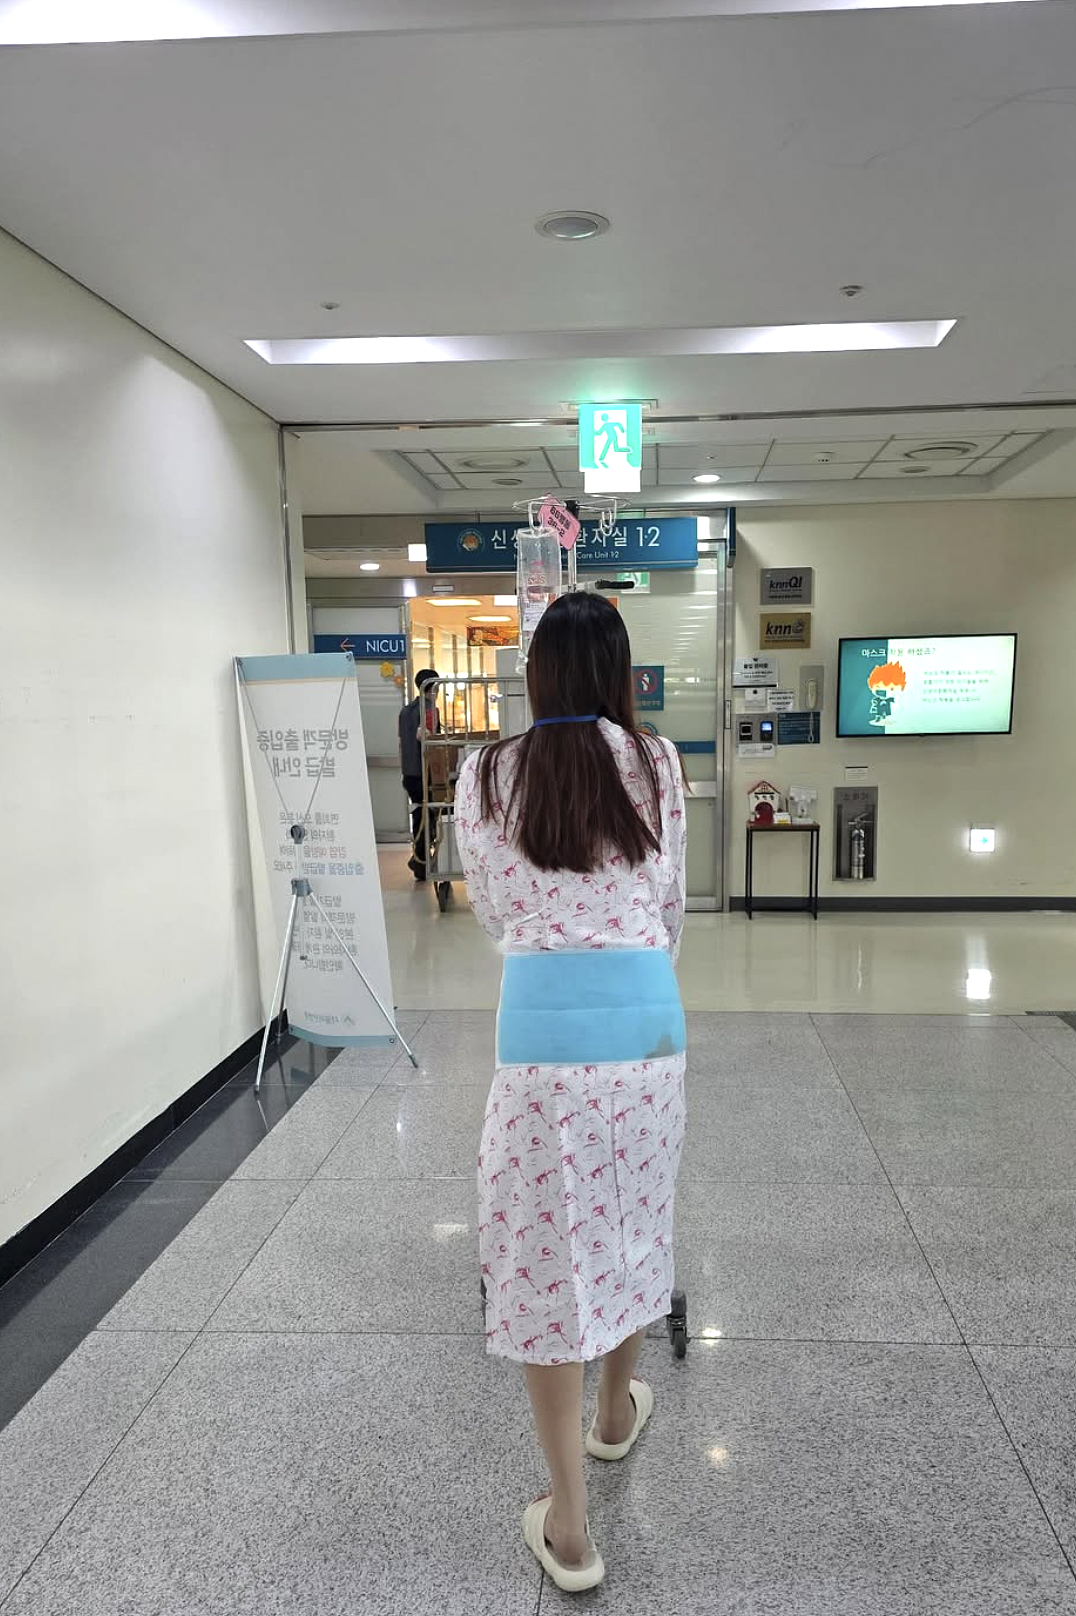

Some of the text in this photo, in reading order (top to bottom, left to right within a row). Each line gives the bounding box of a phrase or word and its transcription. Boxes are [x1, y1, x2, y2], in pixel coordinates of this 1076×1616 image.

[594, 551, 609, 559] Unit
[366, 639, 405, 653] NICU1
[861, 648, 887, 657] 마스크
